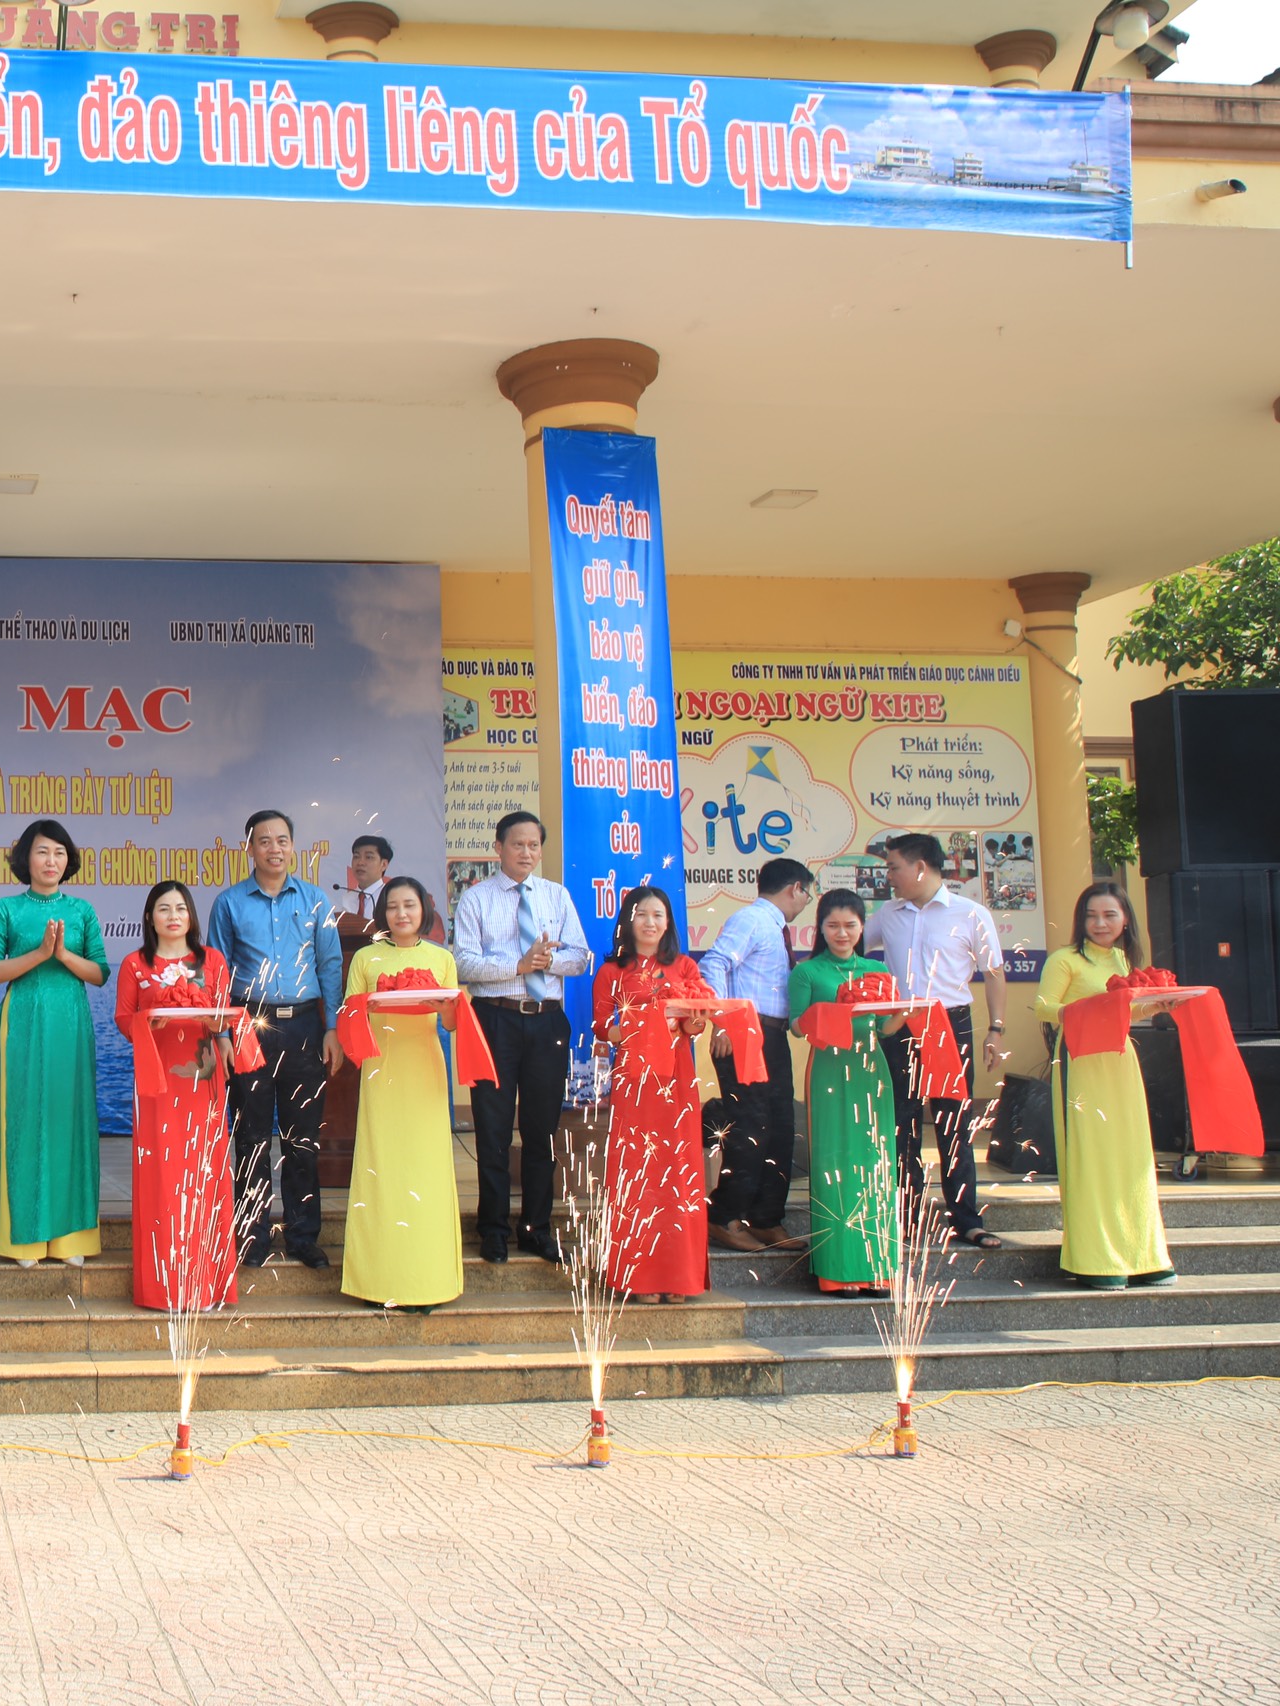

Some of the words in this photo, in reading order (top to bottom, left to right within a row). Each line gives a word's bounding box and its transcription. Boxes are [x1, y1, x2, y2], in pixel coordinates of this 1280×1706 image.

[150, 13, 239, 56] TRỊ
[78, 67, 181, 164] đảo
[195, 77, 369, 191] thiêng
[384, 85, 519, 197] liêng
[533, 85, 633, 183] của
[640, 81, 710, 189] Tổ
[725, 93, 851, 210] quốc
[566, 493, 618, 543] Quyết
[619, 500, 650, 540] tâm
[583, 559, 610, 604] giữ
[614, 561, 644, 608] gìn,
[25, 619, 57, 640] THAO
[61, 614, 78, 641] VÀ
[81, 620, 98, 641] DU
[101, 621, 130, 646] LỊCH
[170, 621, 204, 642] UBND
[206, 622, 228, 648] THỊ
[231, 617, 247, 643] XÃ
[250, 617, 291, 647] QUẢNG
[294, 623, 314, 649] TRỊ
[589, 618, 621, 660] bảo
[624, 624, 644, 671] vệ
[458, 661, 478, 679] DỤC
[481, 659, 495, 675] VÀ
[498, 659, 518, 676] ĐÀO
[732, 662, 759, 679] CÔNG
[762, 665, 774, 679] TY
[777, 665, 803, 679] TNHH
[806, 664, 819, 679] TƯ
[821, 661, 841, 680] VẤN
[844, 664, 857, 680] VÀ
[860, 664, 884, 680] PHÁT
[887, 661, 916, 680] TRIỂN
[919, 664, 942, 681] GIÁO
[945, 667, 965, 685] DỤC
[968, 665, 995, 682] CÁNH
[17, 684, 193, 750] MẠC
[581, 676, 624, 731] biển,
[628, 684, 657, 728] đảo
[685, 688, 790, 725] NGOẠI
[793, 684, 866, 720] NGỮ
[868, 691, 946, 722] KITE
[487, 730, 517, 747] HỌC
[682, 729, 713, 746] NGỮ
[899, 736, 939, 751] Phát
[943, 733, 982, 751] triển:
[450, 761, 464, 773] Anh
[492, 762, 505, 774] 3-5
[572, 747, 627, 798] thiêng
[631, 750, 674, 799] liêng
[891, 764, 913, 783] Kỹ
[918, 764, 953, 783] năng
[958, 760, 995, 784] sống,
[9, 772, 67, 815] TRƯNG
[71, 767, 106, 815] BÀY
[108, 772, 133, 815] TƯ
[134, 769, 173, 824] LIỆU
[450, 781, 465, 792] Anh
[467, 781, 483, 795] giao
[501, 781, 514, 792] cho
[516, 782, 529, 795] mọi
[870, 791, 892, 810] Kỹ
[897, 791, 932, 811] năng
[936, 787, 980, 811] thuyết
[984, 791, 1020, 807] trình
[451, 800, 466, 811] Anh
[468, 799, 484, 811] sách
[487, 800, 502, 813] giáo
[505, 799, 522, 811] khoa
[452, 819, 466, 830] Anh
[610, 810, 641, 853] của
[455, 838, 465, 849] thi
[100, 840, 157, 886] CHỨNG
[201, 837, 226, 886] SỬ
[227, 841, 251, 886] VÀ
[592, 869, 616, 918] Tổ
[103, 914, 141, 938] năm
[1014, 960, 1036, 973] 357
